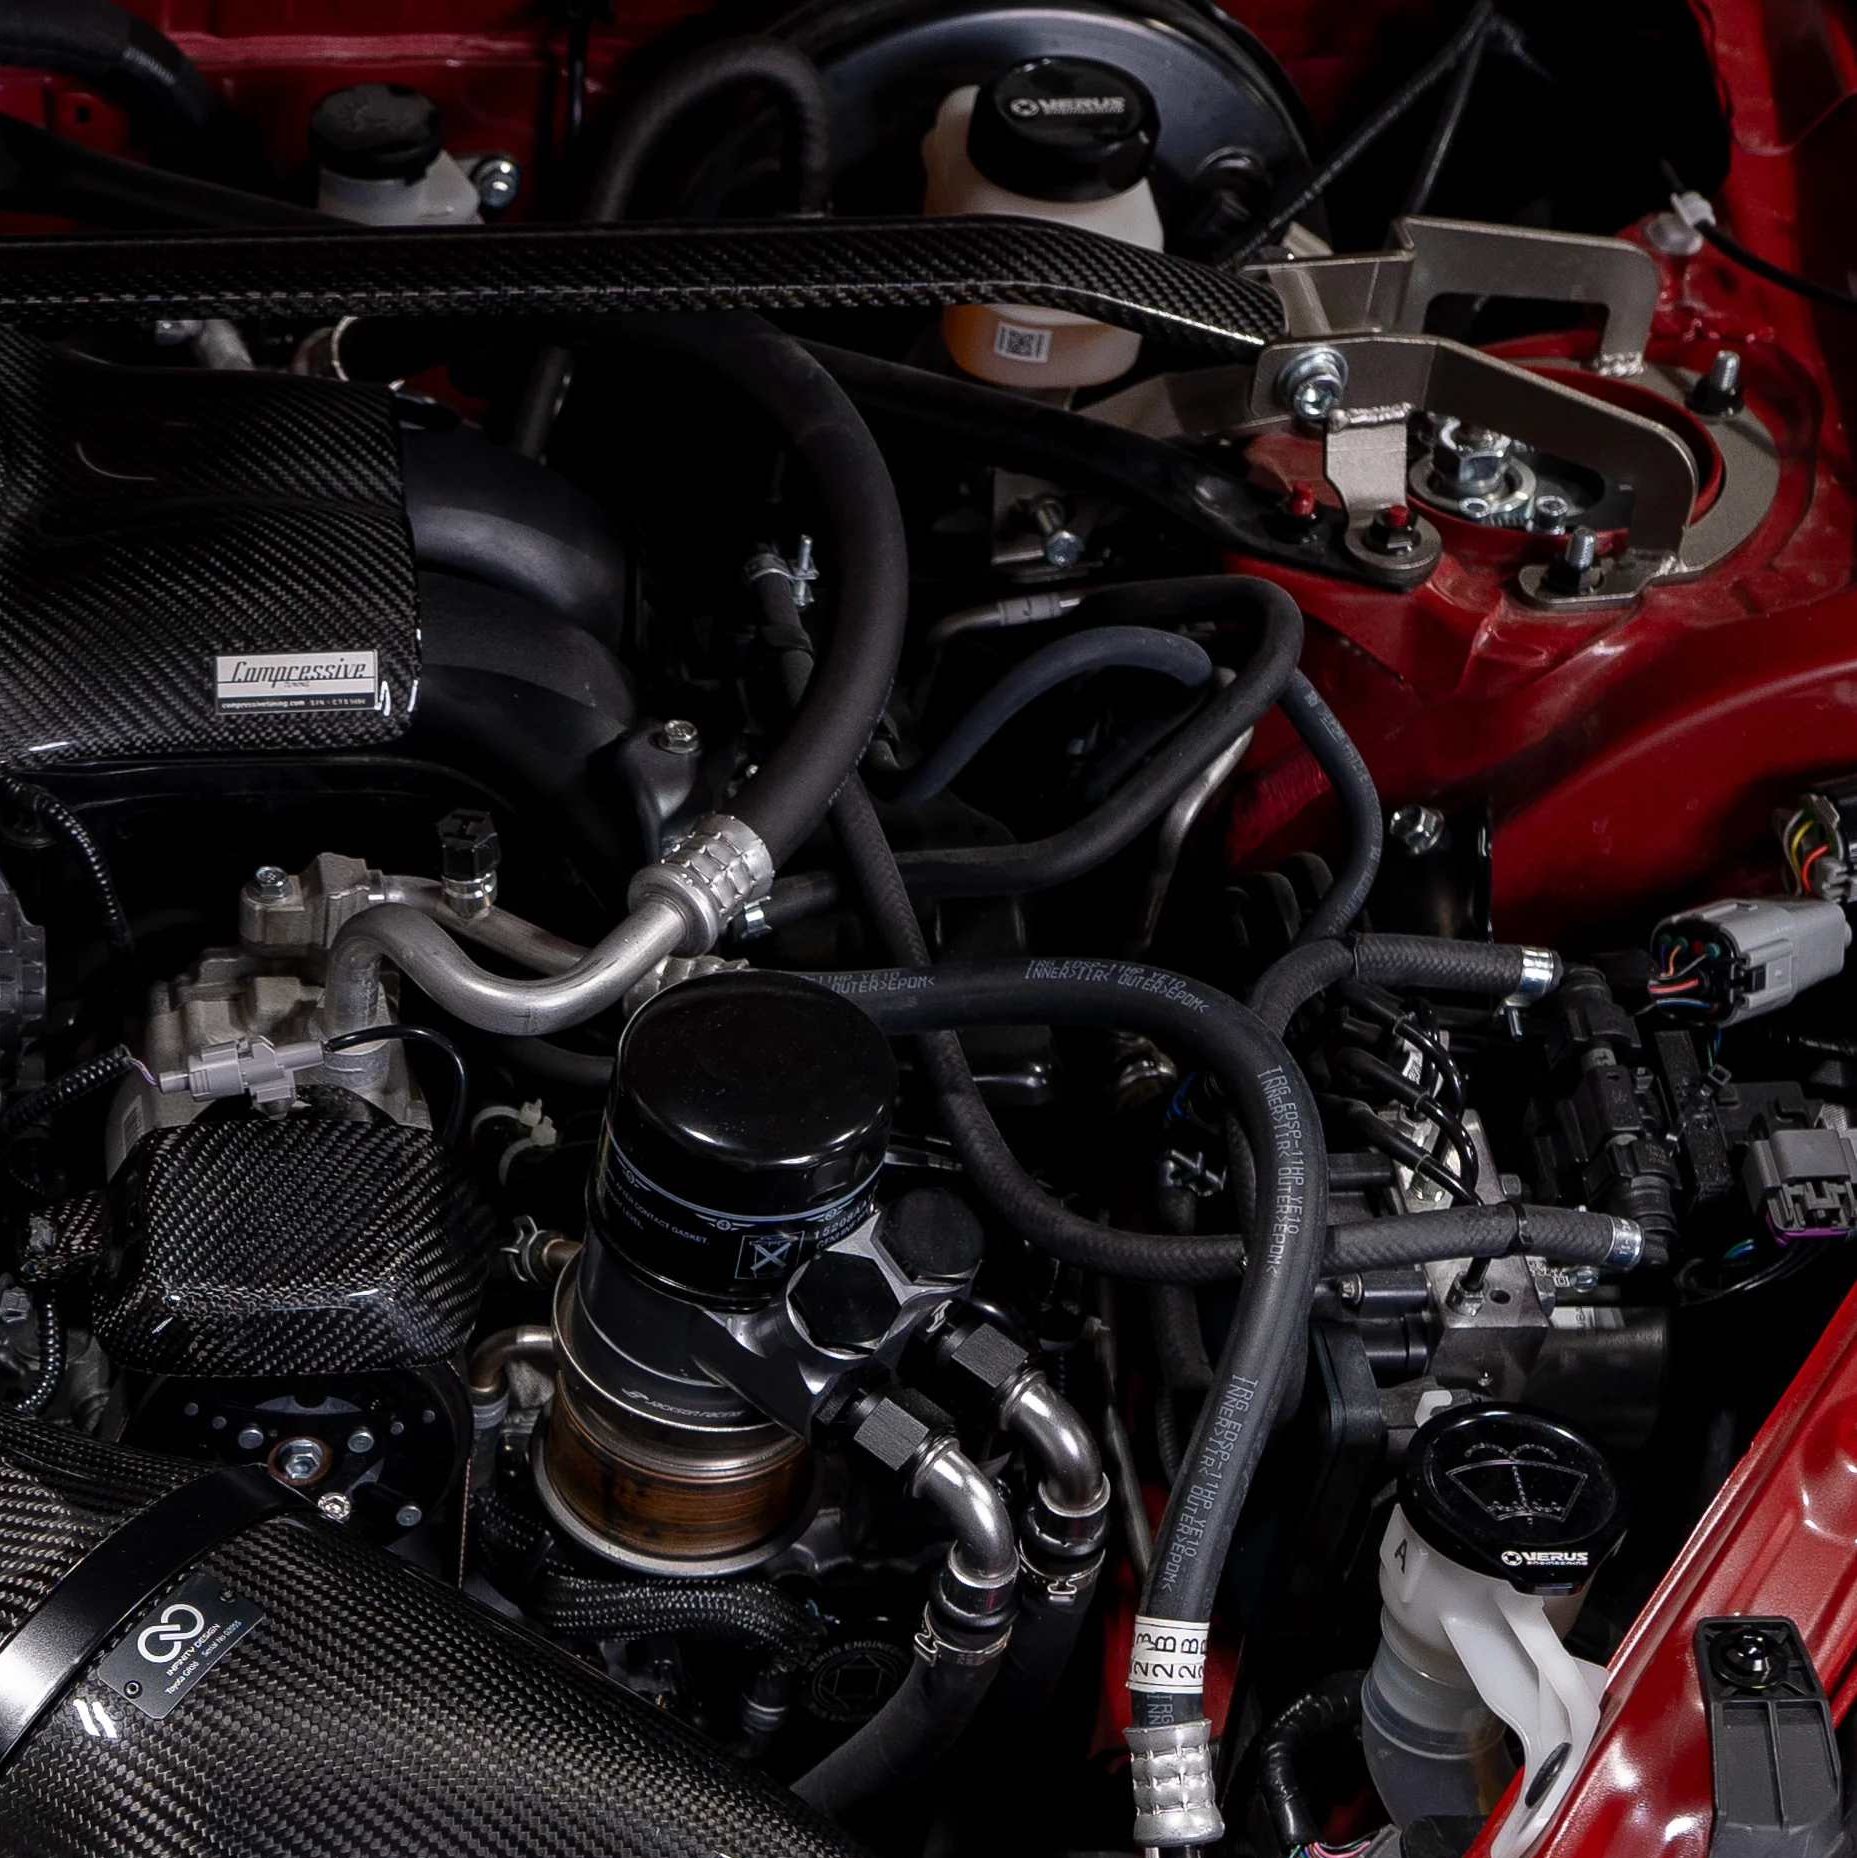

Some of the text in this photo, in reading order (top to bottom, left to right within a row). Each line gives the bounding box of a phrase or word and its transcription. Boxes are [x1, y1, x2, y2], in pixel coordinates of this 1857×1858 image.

[231, 657, 367, 689] Compressive
[1270, 1064, 1292, 1096] TRG
[634, 1201, 670, 1229] CONTACT
[1233, 1375, 1259, 1413] TRG
[1394, 1541, 1408, 1575] A
[1520, 1551, 1589, 1561] VERUS
[166, 1623, 222, 1677] INFINITY DESIGN
